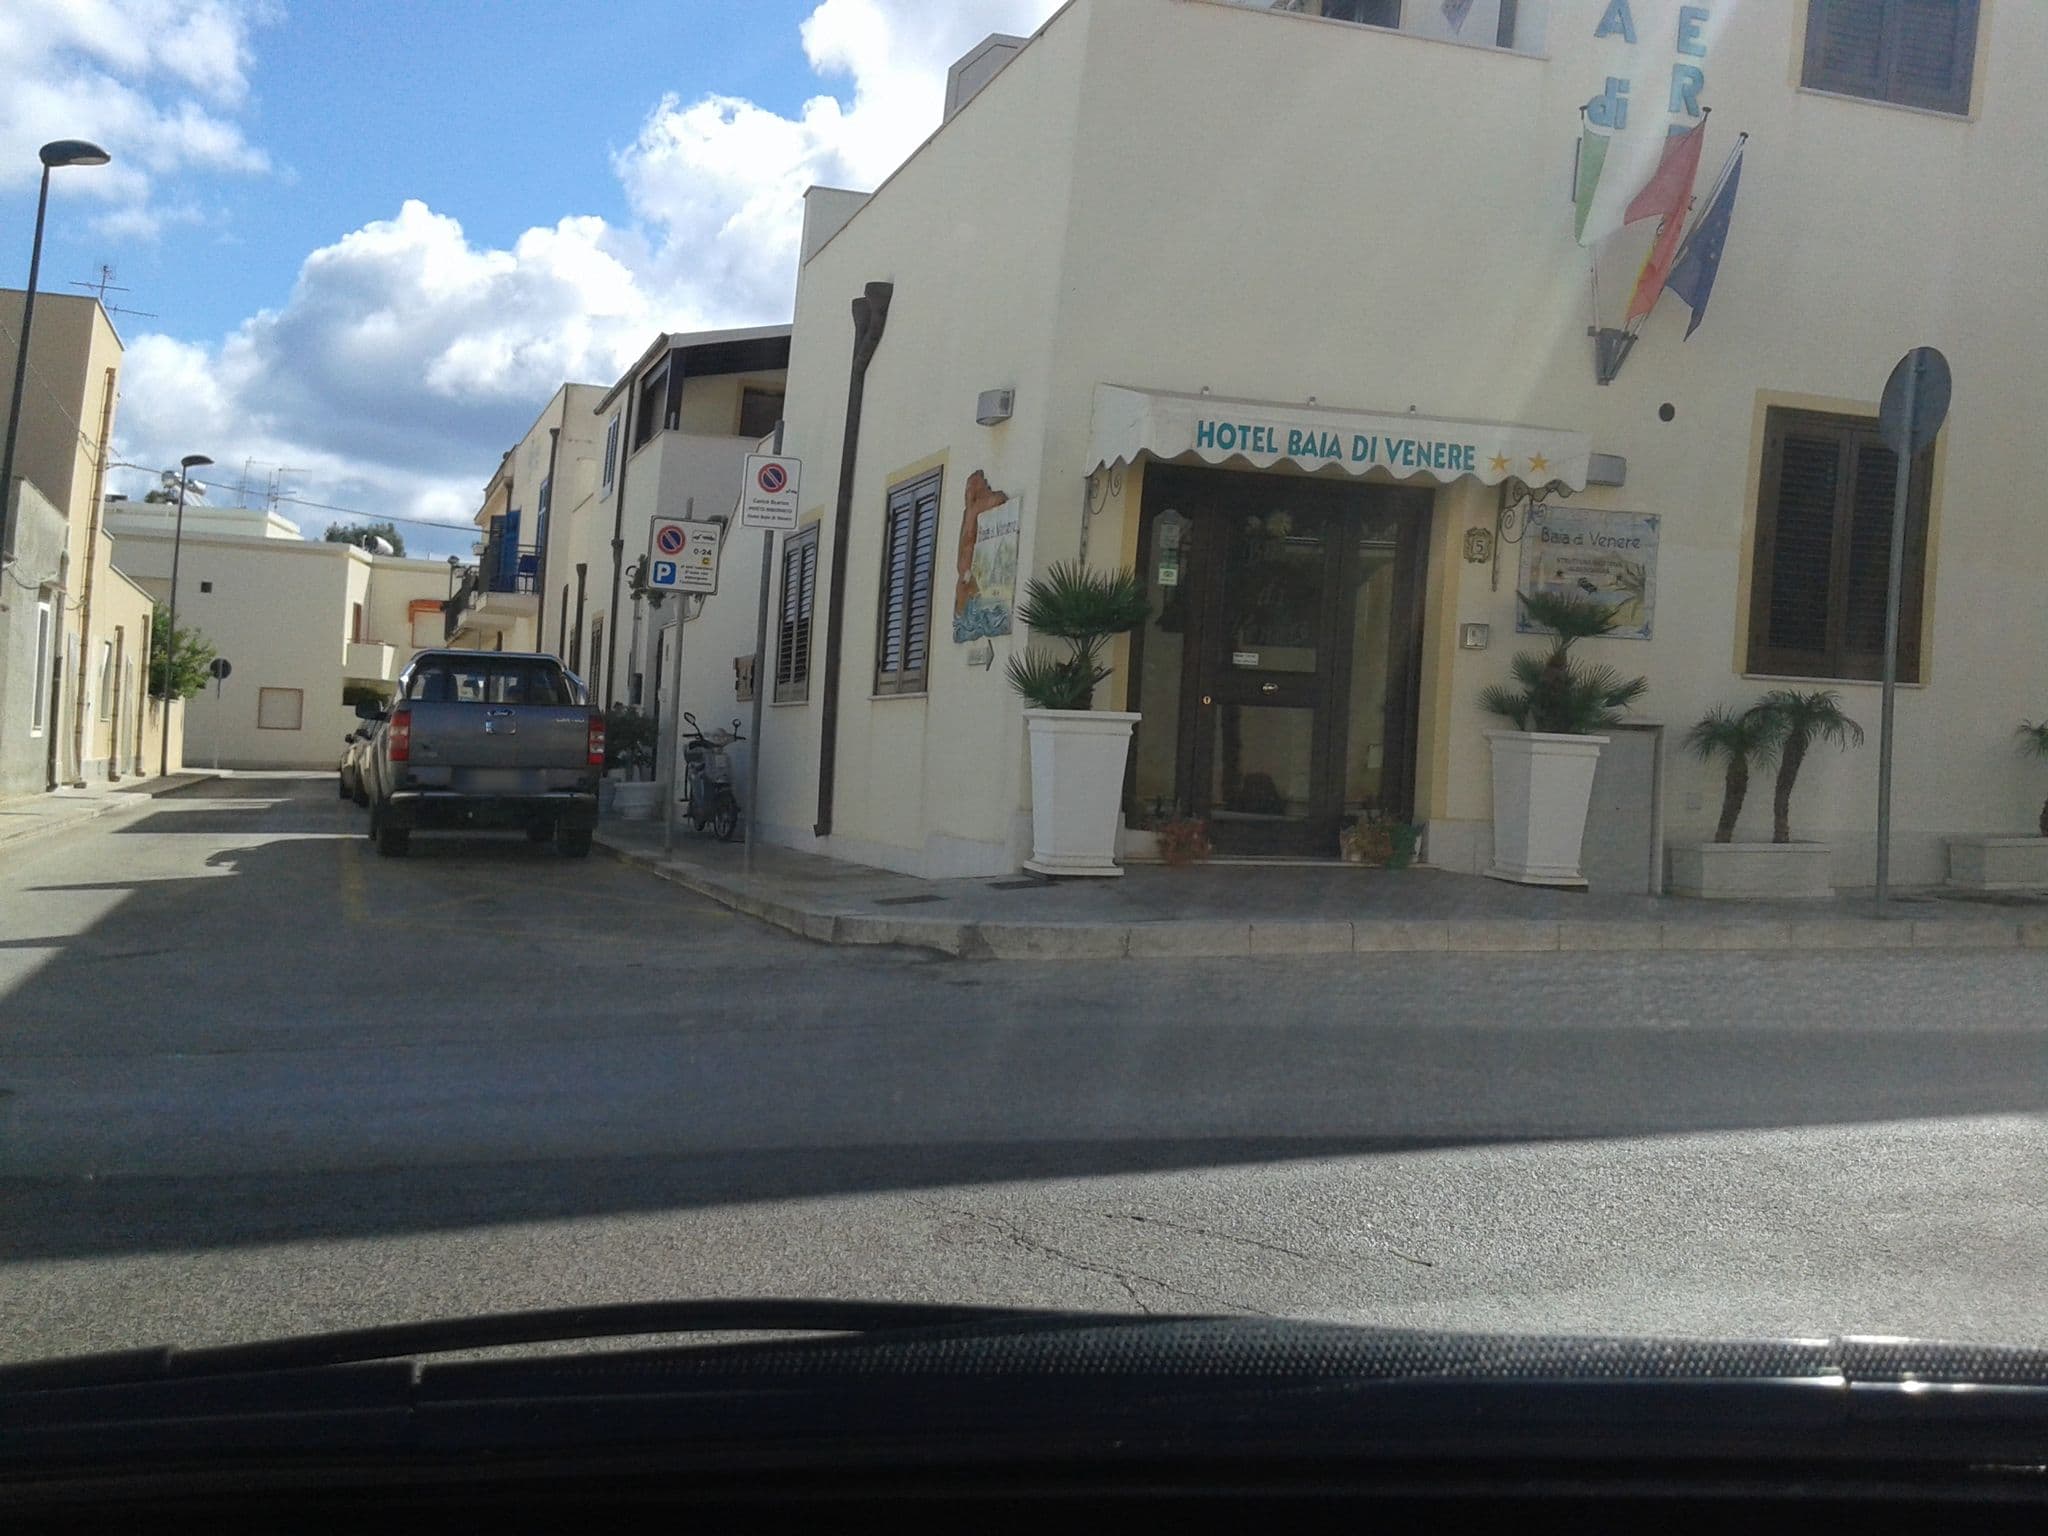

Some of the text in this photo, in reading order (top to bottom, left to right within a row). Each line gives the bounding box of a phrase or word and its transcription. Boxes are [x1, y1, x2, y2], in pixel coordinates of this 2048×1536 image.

[1586, 77, 1630, 129] di
[1197, 420, 1476, 472] HOTEL BAIA DI VENERE
[1589, 531, 1641, 549] Venere
